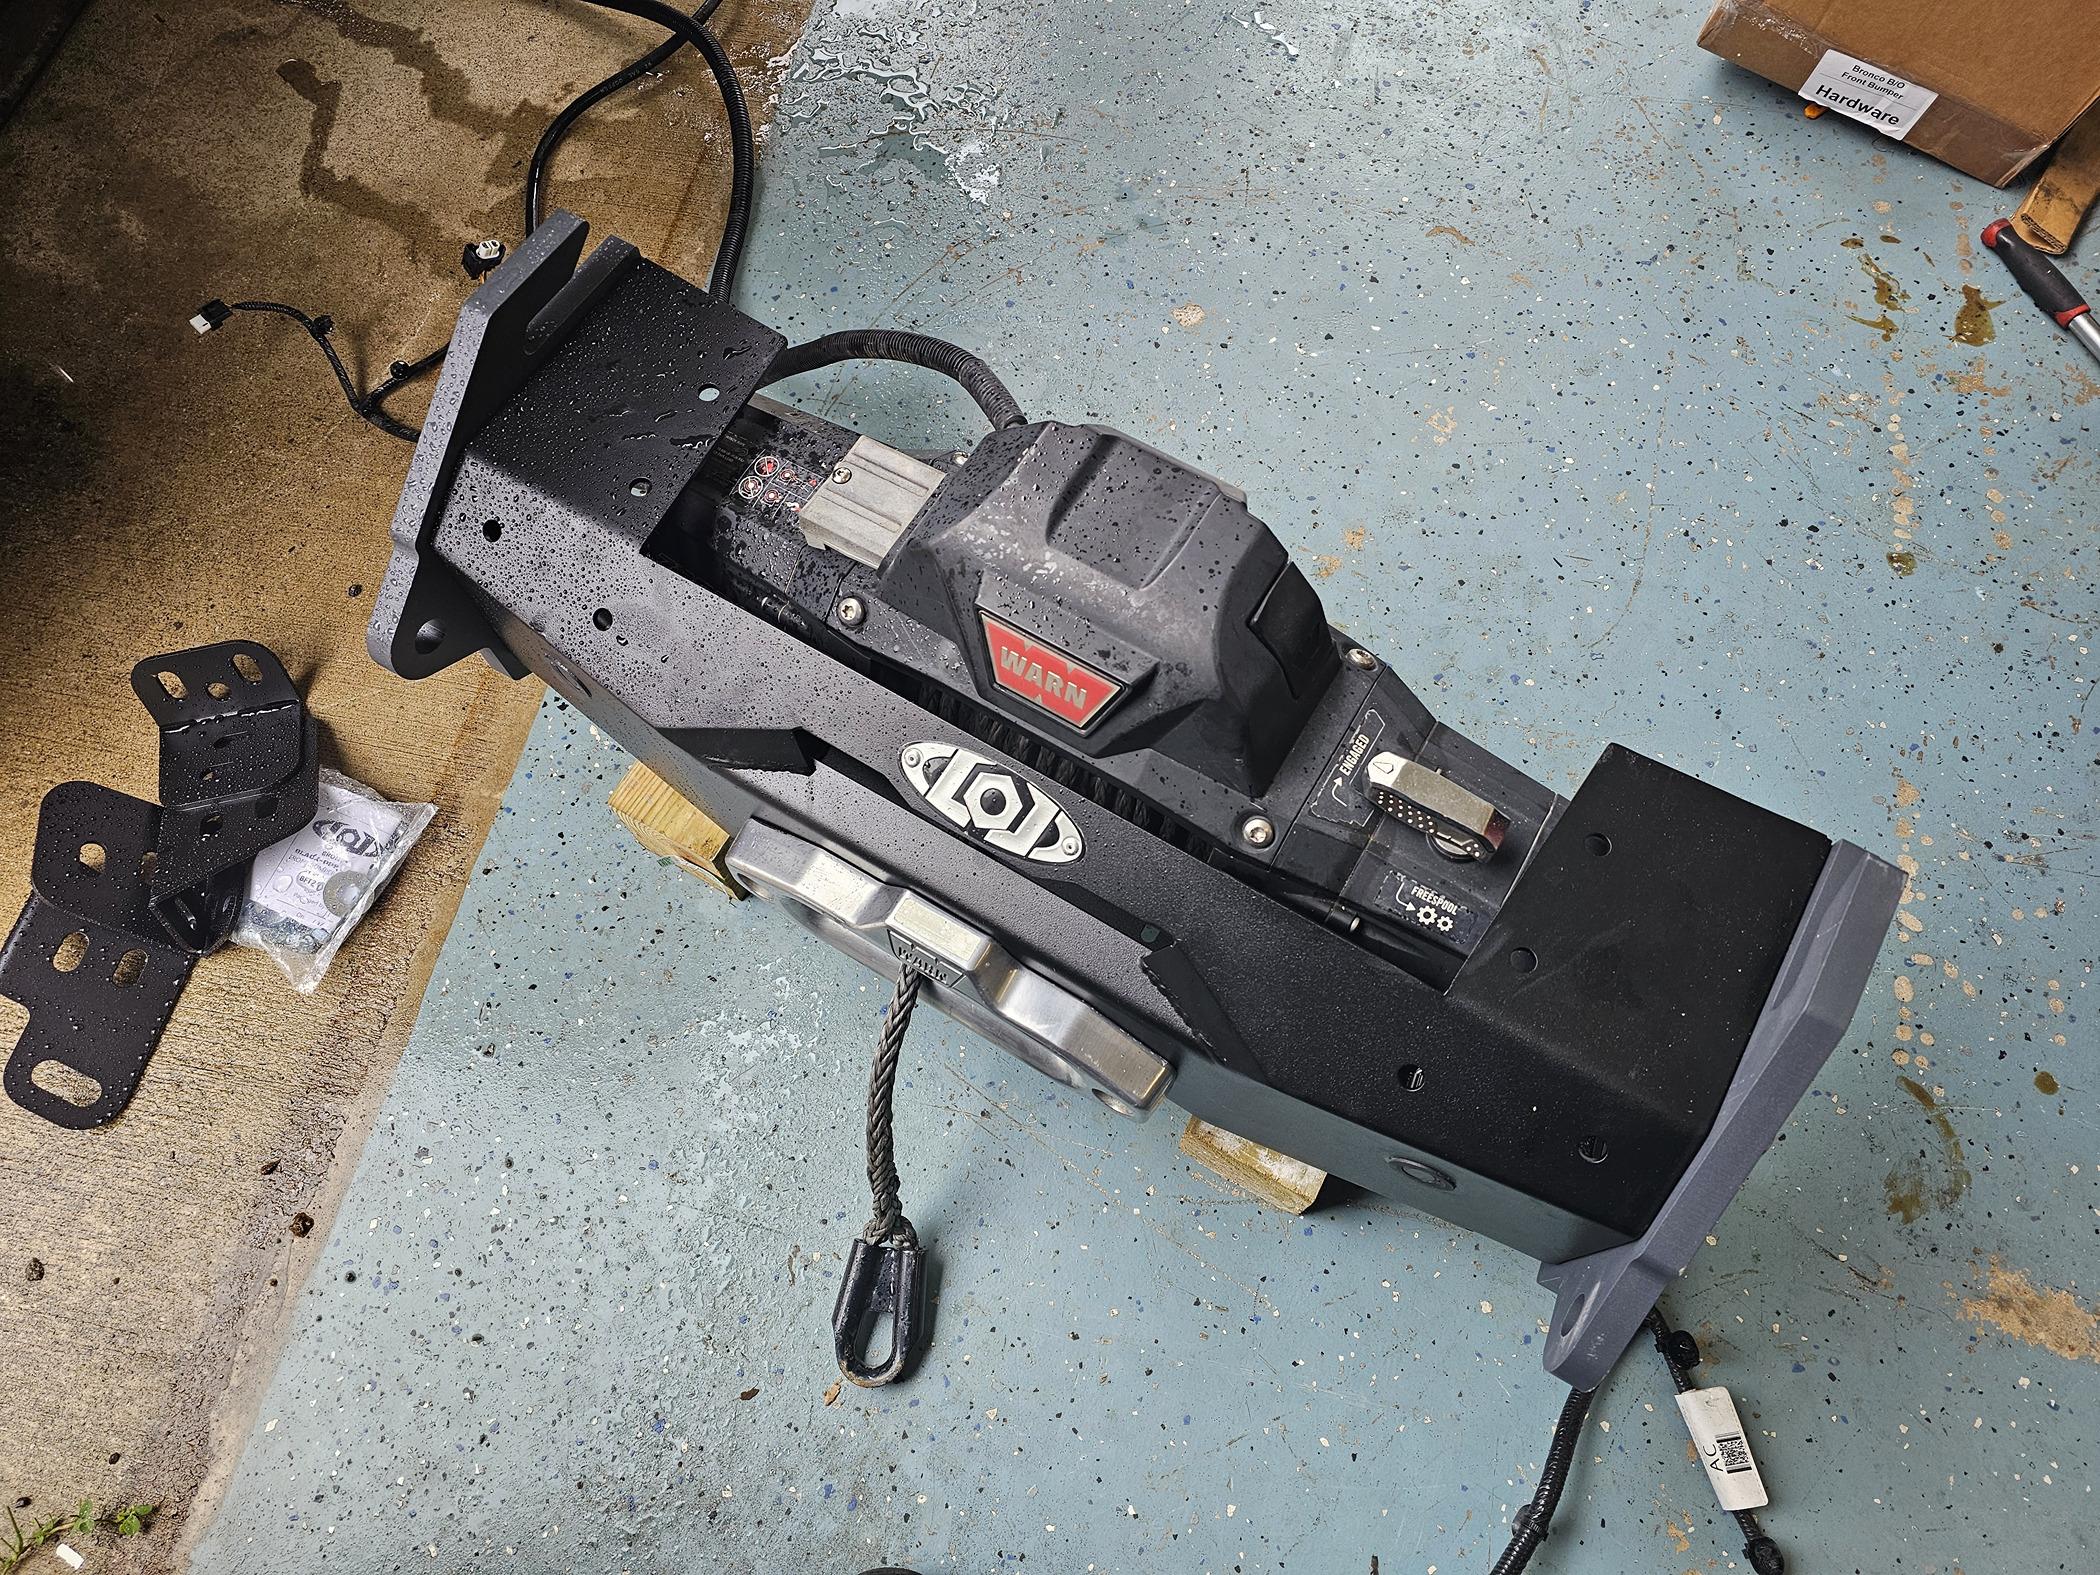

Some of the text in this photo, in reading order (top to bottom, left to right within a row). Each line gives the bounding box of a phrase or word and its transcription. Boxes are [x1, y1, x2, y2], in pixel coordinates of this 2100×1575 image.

[1841, 71, 1904, 100] Front Bumper
[1851, 64, 1906, 90] Bronco B/O
[1815, 84, 1900, 126] Hardware
[1000, 646, 1088, 710] WARN
[1339, 733, 1370, 777] ENGAGED
[1411, 886, 1458, 916] FREESPOOL
[1702, 1443, 1724, 1472] AC
